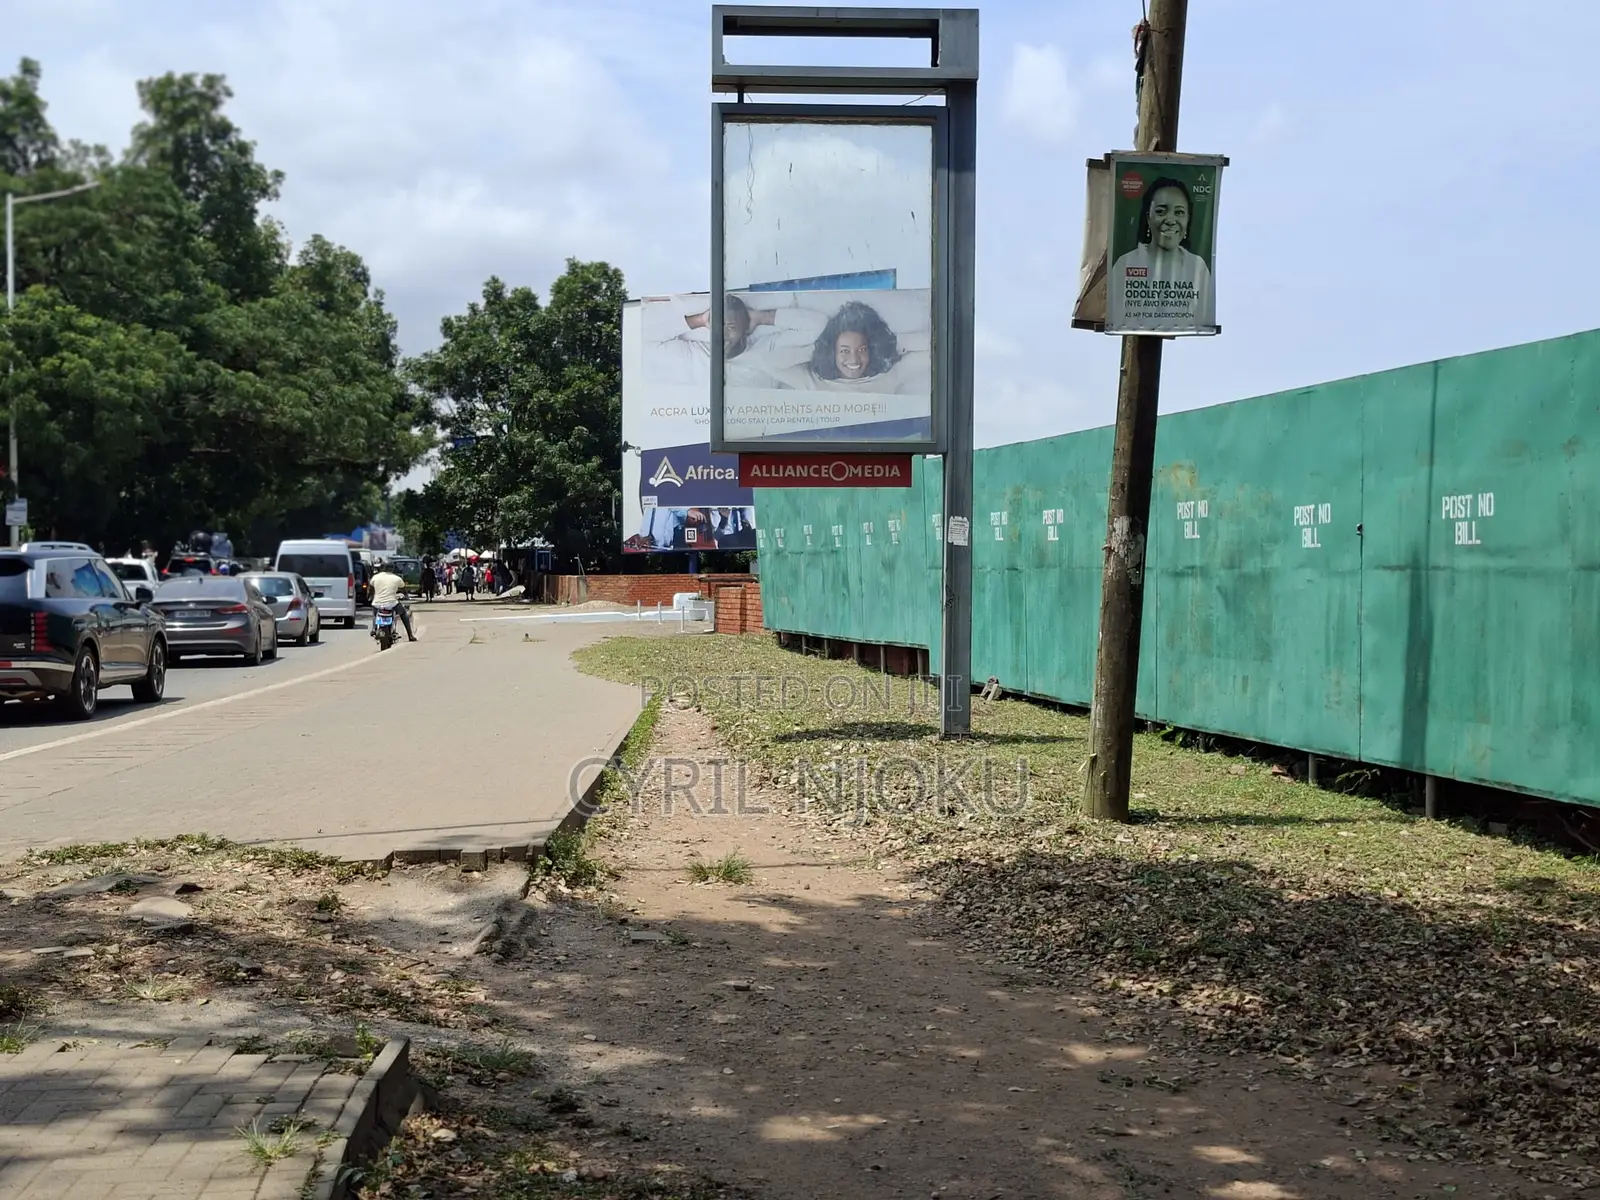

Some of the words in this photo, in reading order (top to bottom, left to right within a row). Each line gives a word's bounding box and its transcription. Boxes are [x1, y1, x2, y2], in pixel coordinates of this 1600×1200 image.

[1125, 281, 1150, 289] HON.
[1152, 281, 1171, 289] RITA
[1174, 281, 1194, 289] NAA
[1125, 290, 1161, 298] ODOLEY
[1164, 290, 1200, 299] SOWAH
[650, 407, 689, 417] ACCRA
[691, 405, 735, 416] LUXRY
[737, 404, 813, 415] APARTMENTS
[815, 403, 841, 414] AND
[844, 402, 887, 413] MORE!!!
[727, 417, 747, 425] LONG
[788, 416, 815, 424] RENTAL
[685, 465, 739, 480] Africa.
[1177, 501, 1195, 520] POST
[1198, 500, 1208, 518] NO
[1294, 504, 1315, 526] POST
[1319, 503, 1331, 524] NO
[1442, 495, 1473, 519] POST
[1478, 492, 1494, 517] NO
[1184, 521, 1200, 539] BILL
[1302, 528, 1321, 548] BILL
[1454, 522, 1481, 545] BILL
